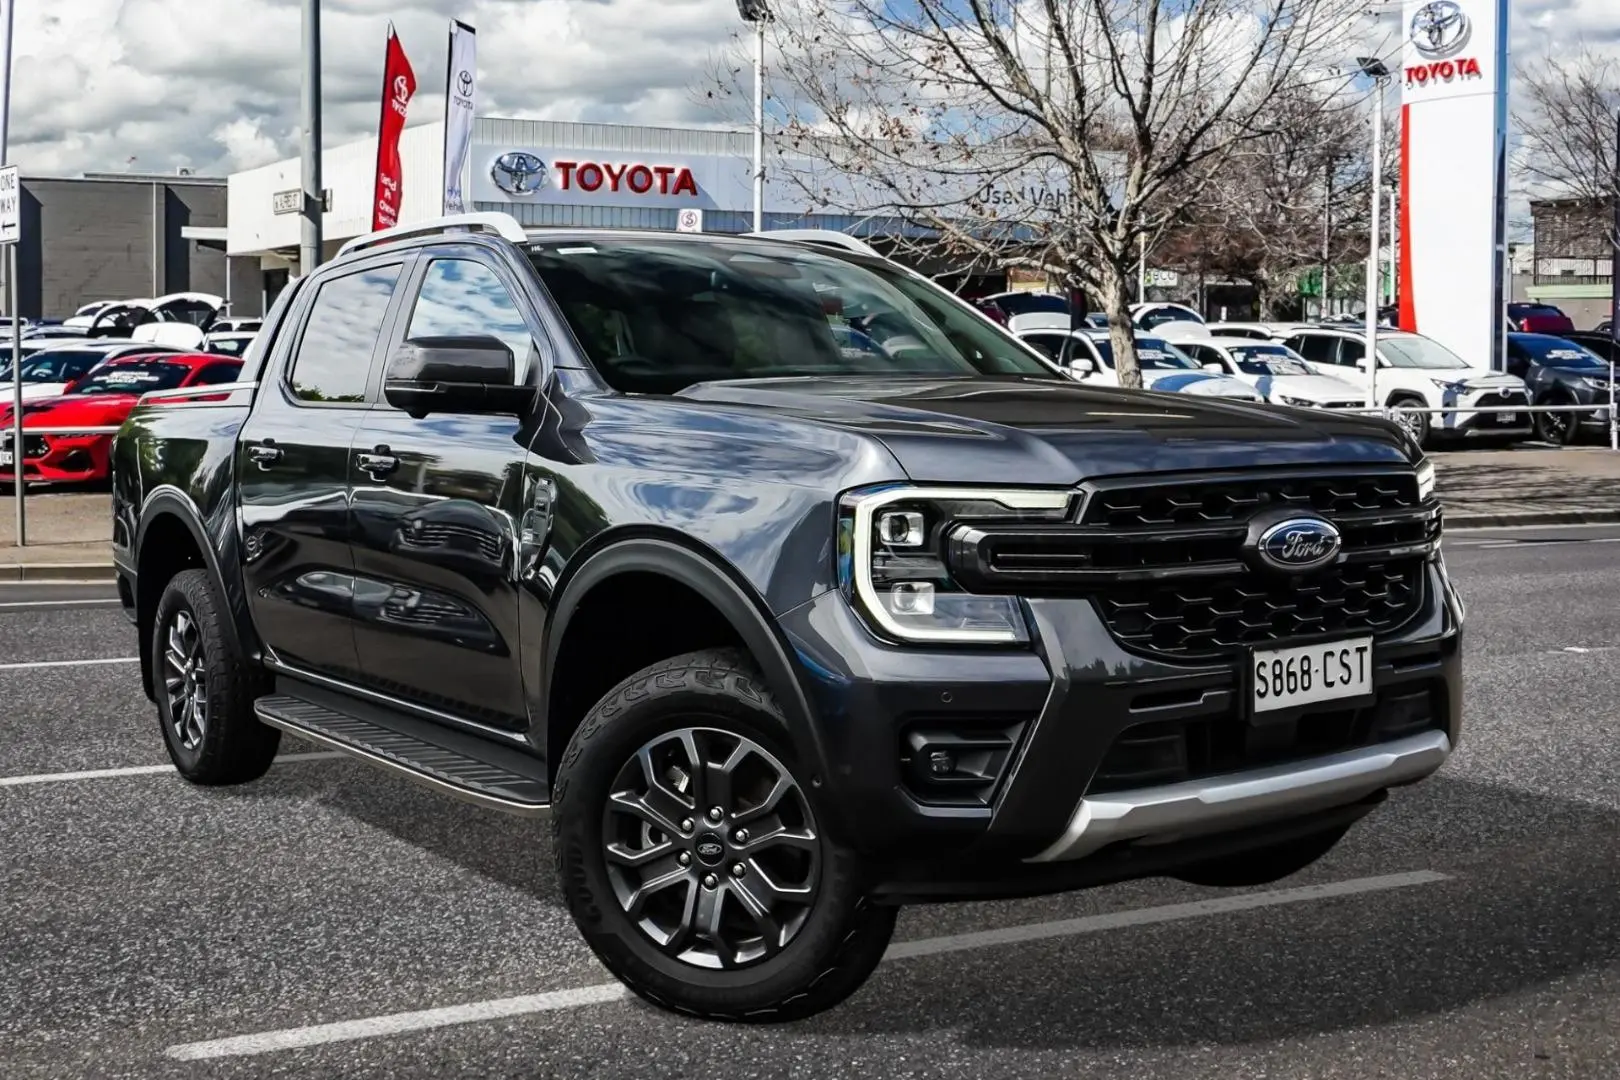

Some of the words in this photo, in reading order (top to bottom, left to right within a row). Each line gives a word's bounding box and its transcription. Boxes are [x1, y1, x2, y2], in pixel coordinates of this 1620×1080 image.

[1404, 58, 1481, 83] TOYOTA
[0, 172, 16, 192] ONE
[555, 161, 698, 196] TOYOTA
[0, 196, 17, 214] WAY
[1282, 530, 1332, 559] Ford
